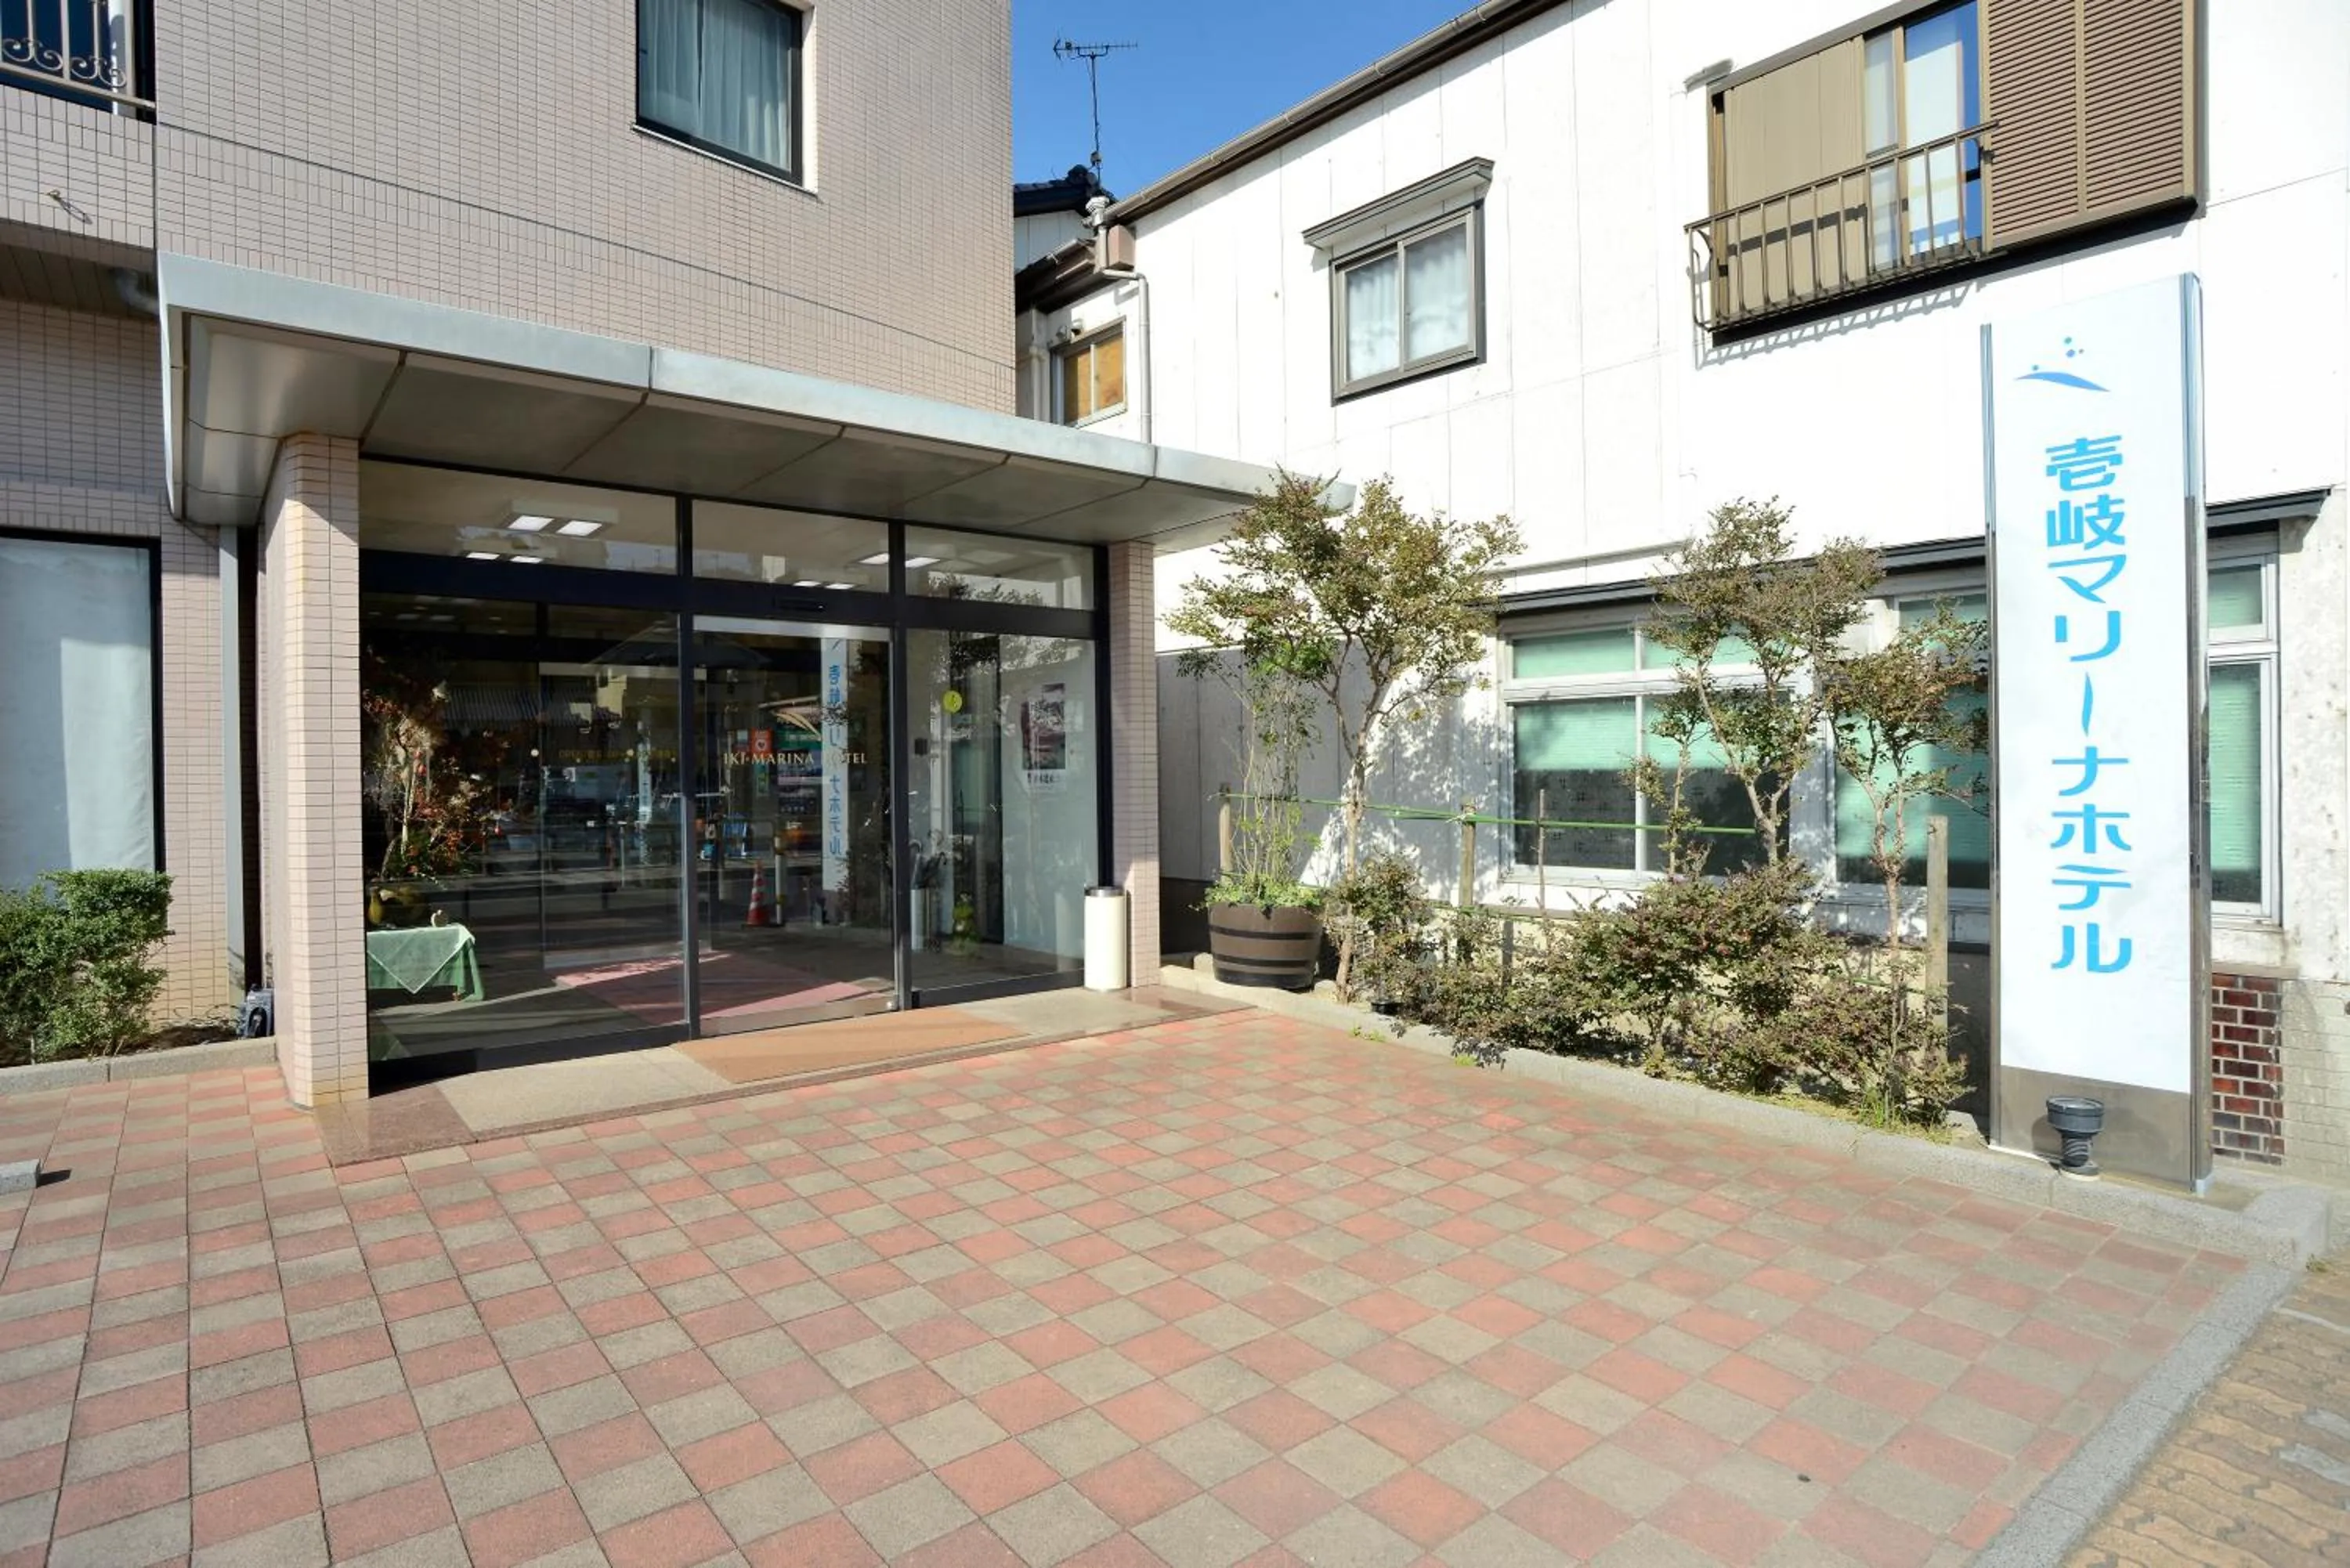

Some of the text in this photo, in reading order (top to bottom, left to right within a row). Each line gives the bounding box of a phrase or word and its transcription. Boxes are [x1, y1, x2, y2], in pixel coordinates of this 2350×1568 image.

[2045, 435, 2132, 973] 壱岐マリーナホテル
